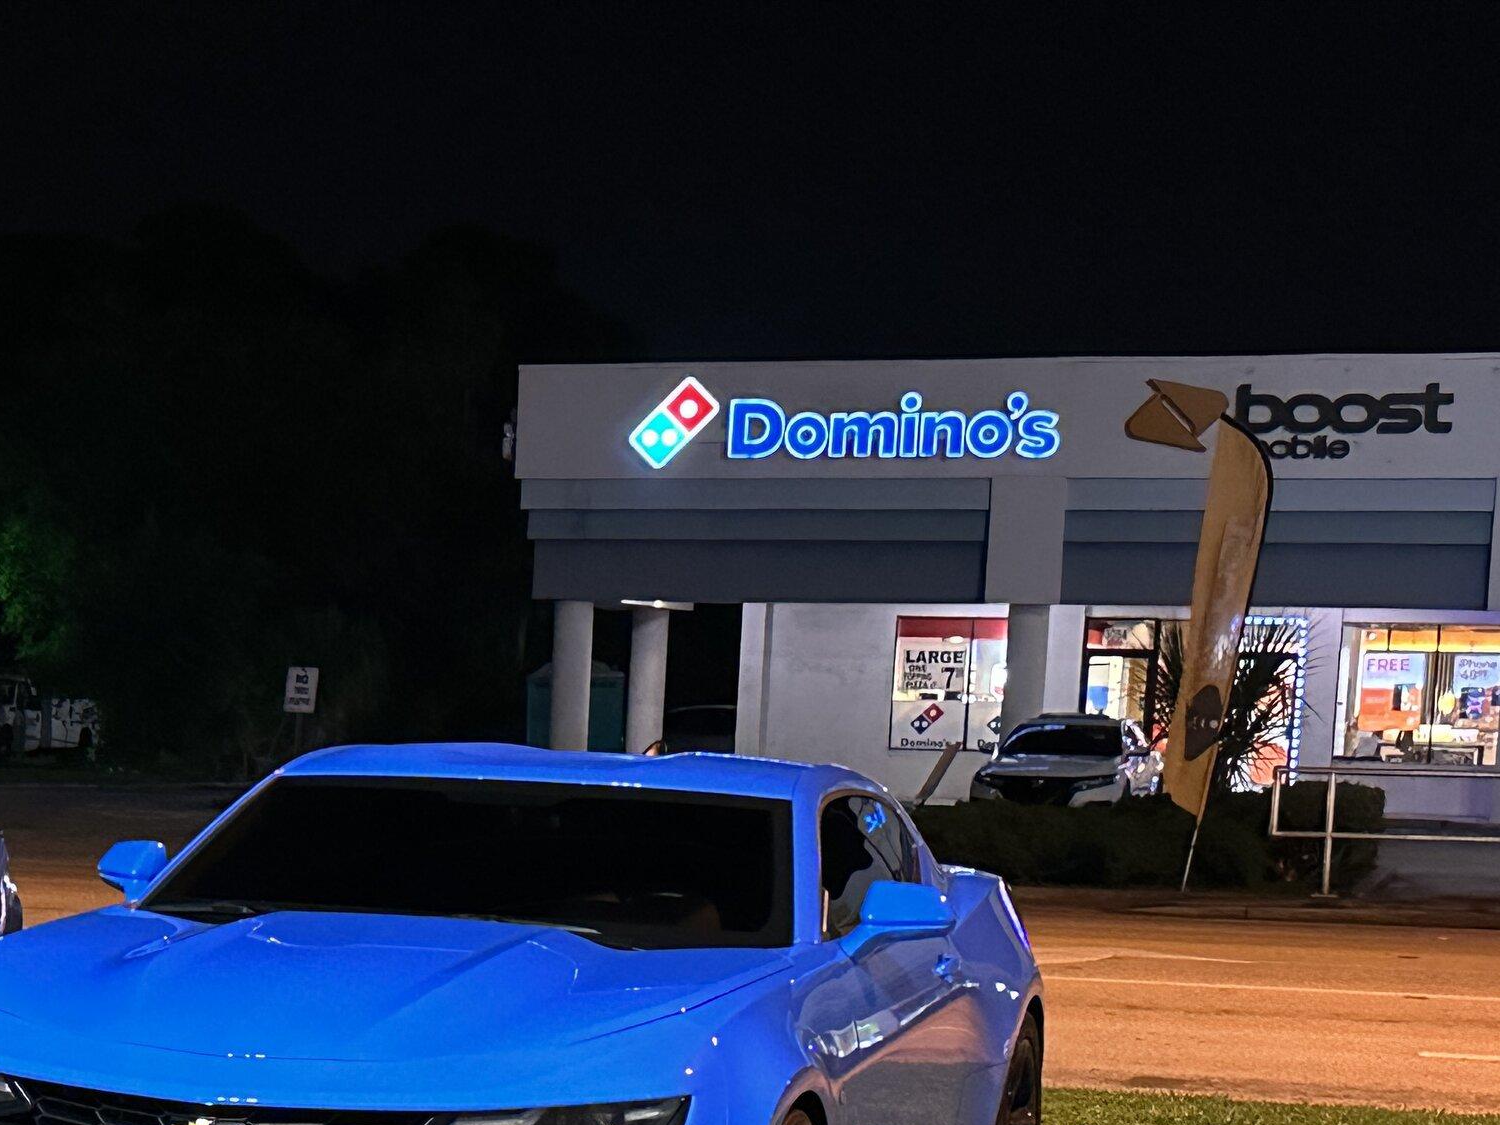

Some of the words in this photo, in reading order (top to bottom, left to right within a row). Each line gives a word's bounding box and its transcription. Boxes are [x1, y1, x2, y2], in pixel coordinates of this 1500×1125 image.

[1236, 383, 1454, 434] boost
[726, 391, 1062, 459] Domino's
[1257, 435, 1350, 459] obile
[906, 650, 965, 664] LARGE
[1366, 658, 1411, 672] FREE
